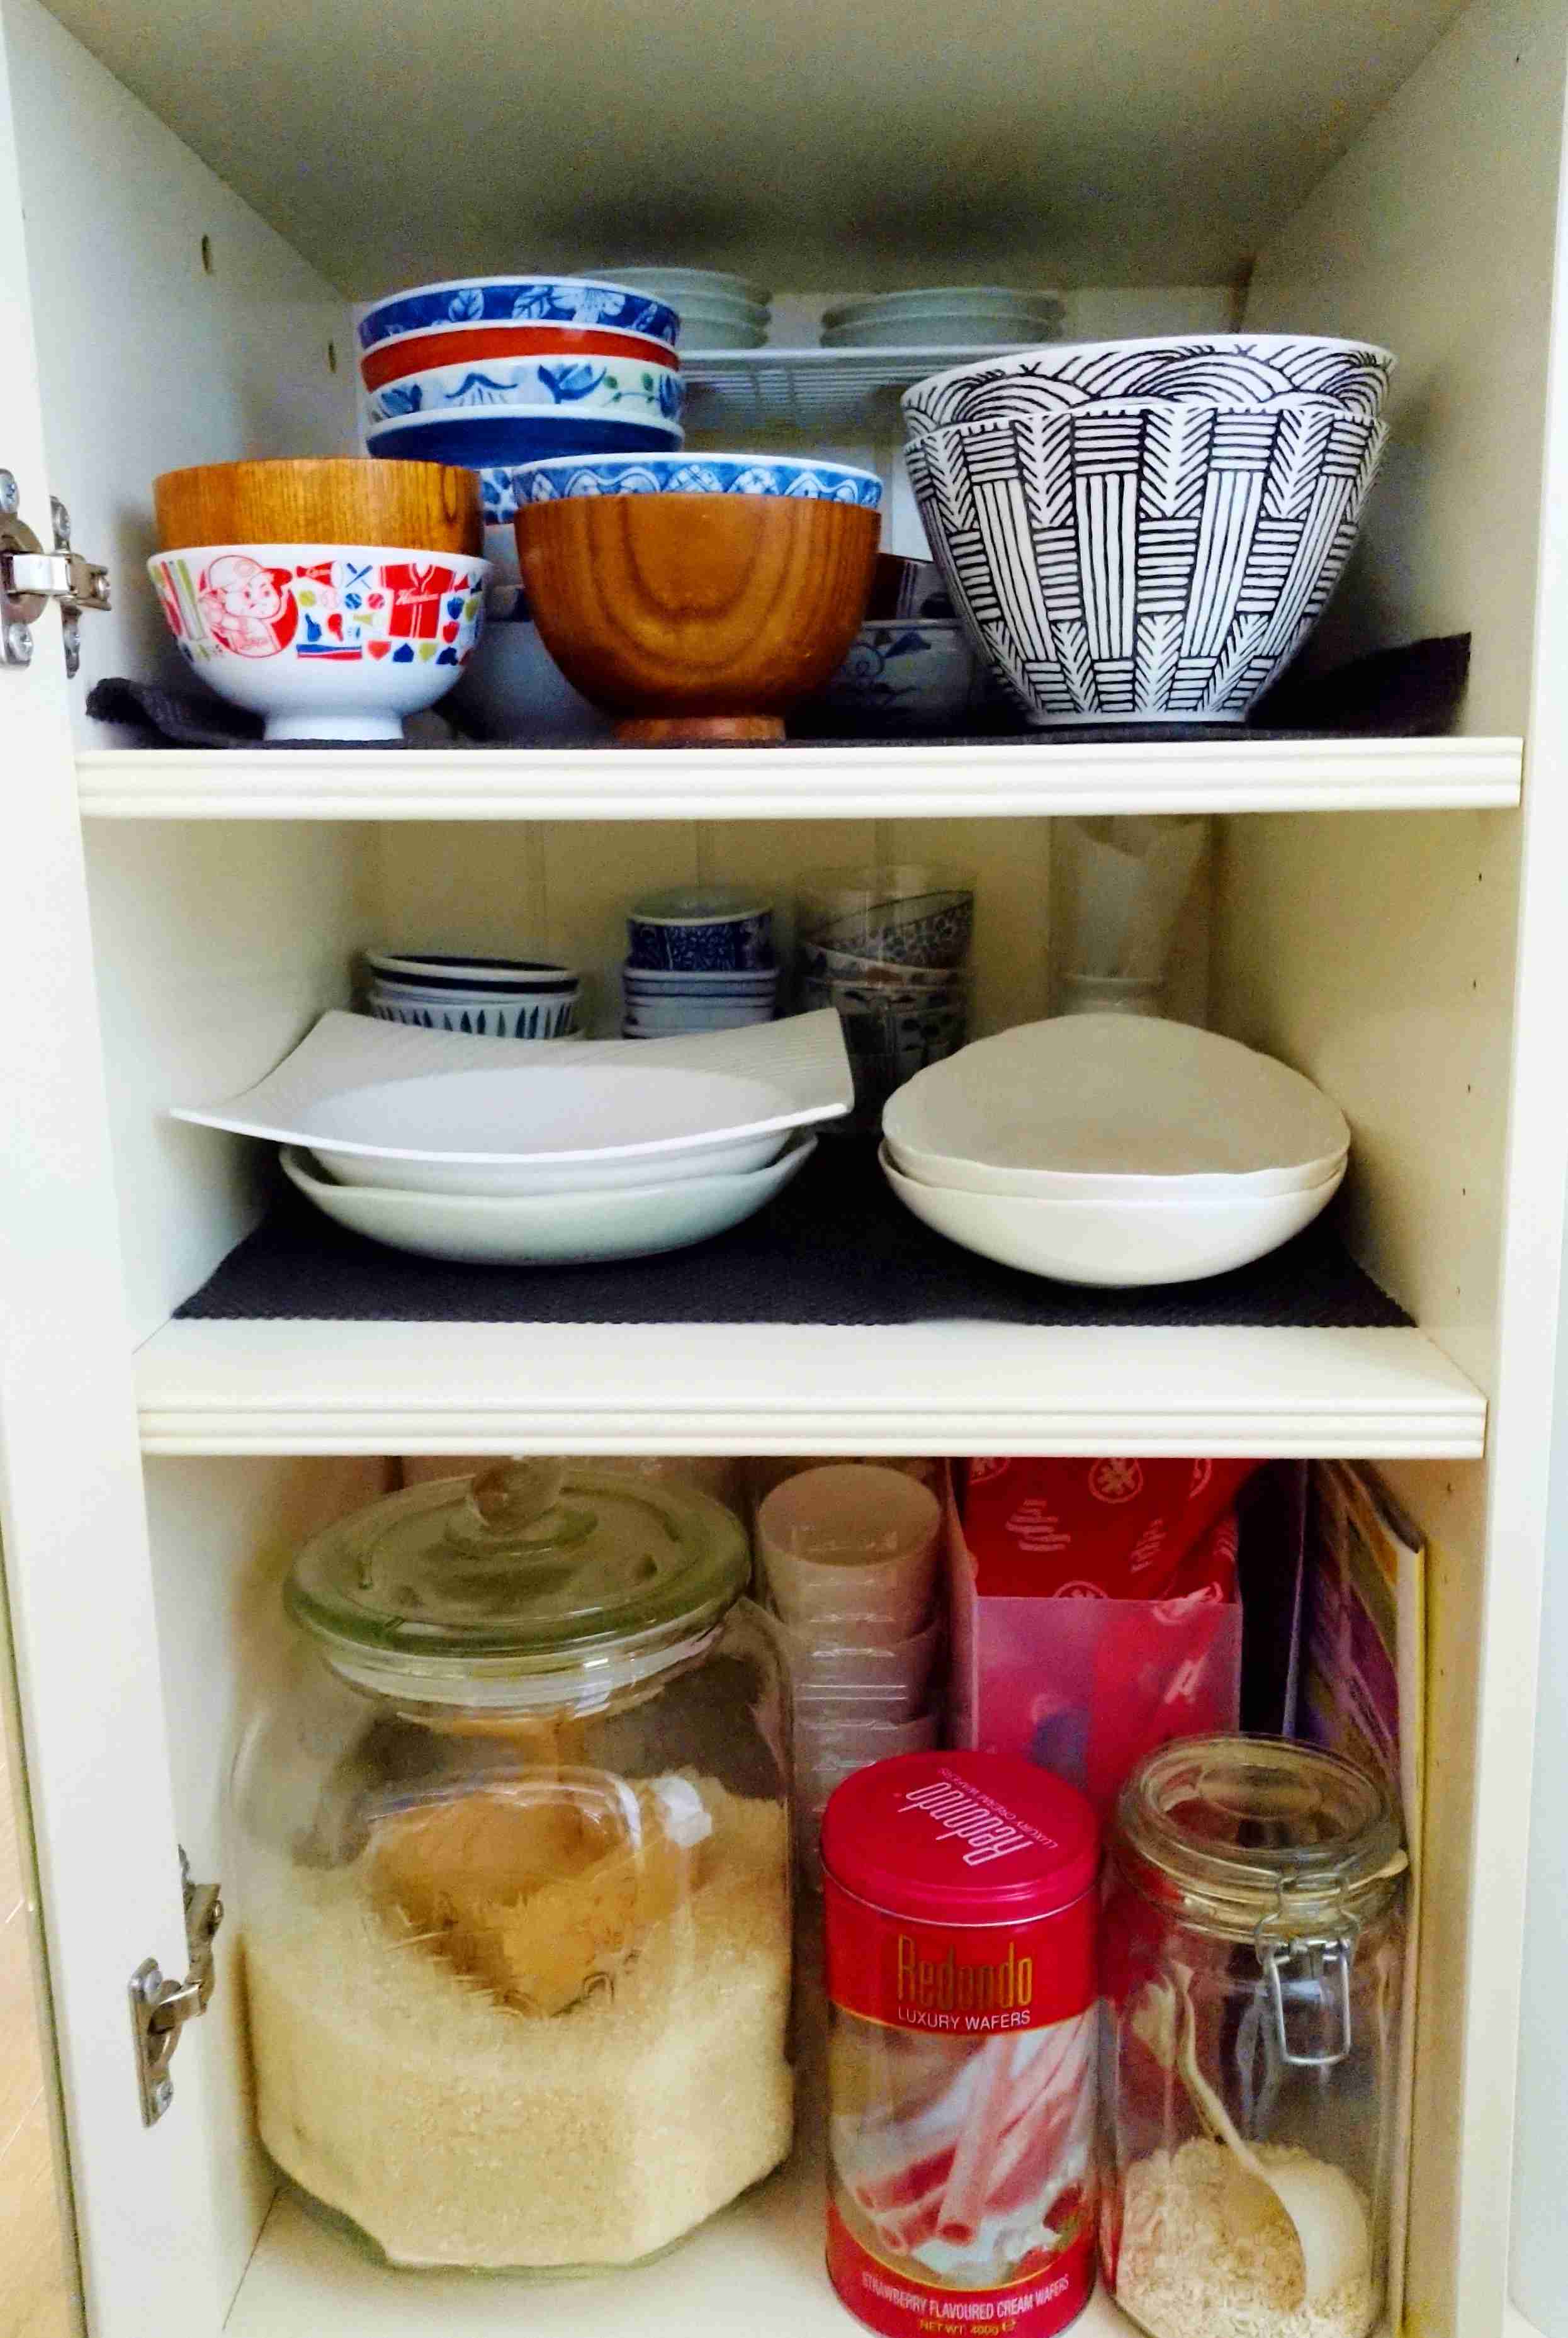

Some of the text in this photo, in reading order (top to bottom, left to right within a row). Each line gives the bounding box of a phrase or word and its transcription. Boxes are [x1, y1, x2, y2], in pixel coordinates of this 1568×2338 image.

[897, 1782, 1034, 1866] Redondo
[897, 1933, 1033, 2011] Redondo
[898, 2006, 1030, 2030] LUXURY WAFERS
[862, 2271, 1069, 2320] STRAWBERRY FLAVOURED CREAM WAFERS
